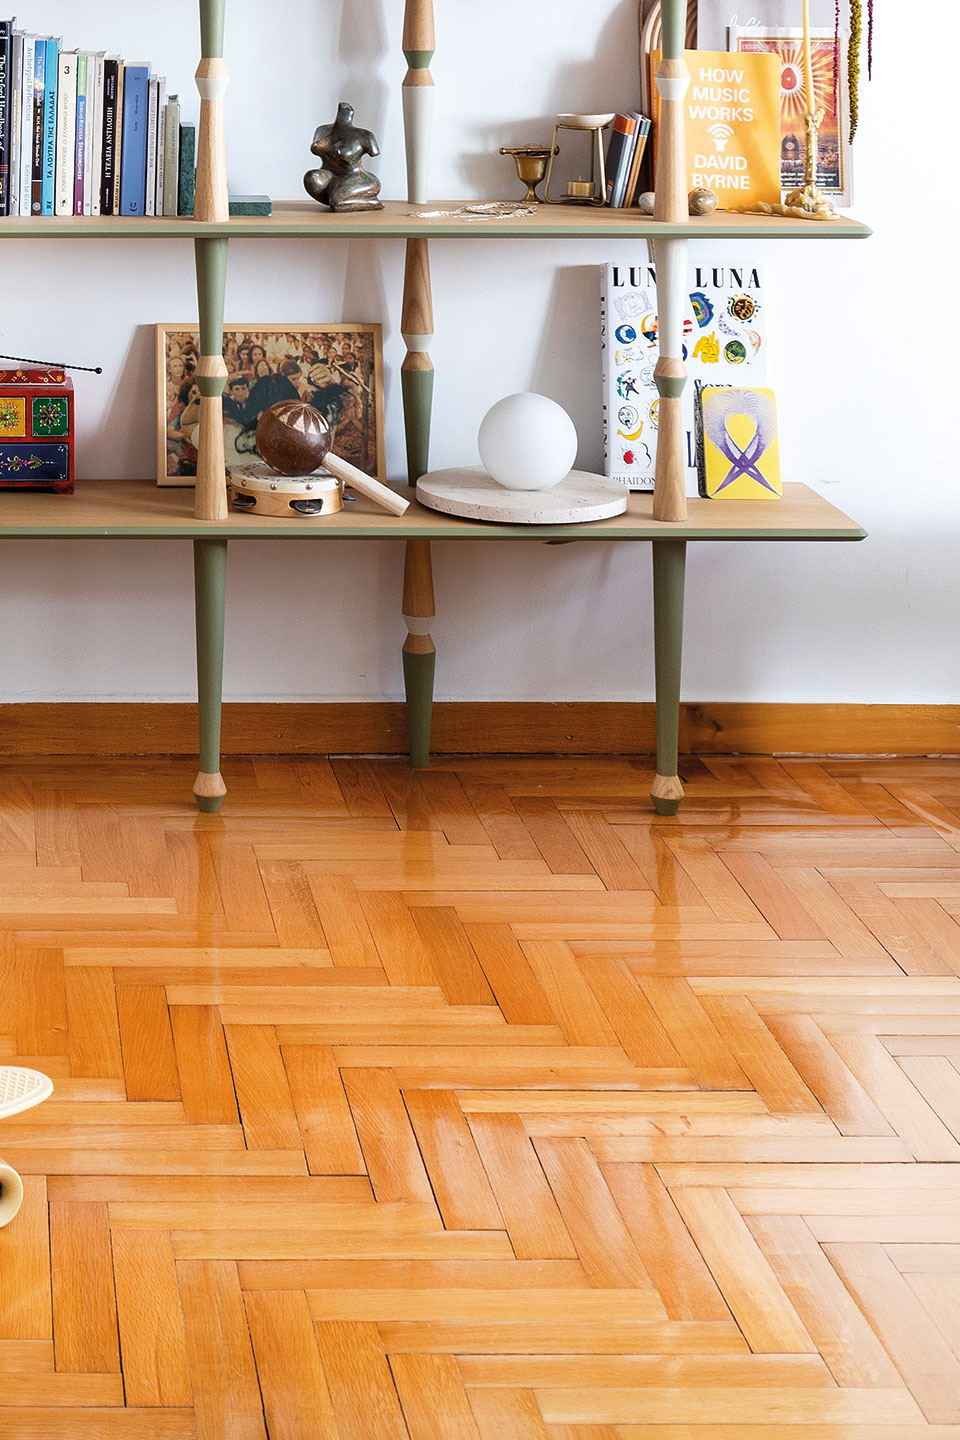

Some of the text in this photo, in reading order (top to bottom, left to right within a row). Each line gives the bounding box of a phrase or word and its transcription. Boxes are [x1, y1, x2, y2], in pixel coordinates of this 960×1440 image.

[64, 65, 70, 75] 3
[699, 68, 744, 84] HOW
[692, 87, 750, 103] MUSIC
[688, 106, 754, 122] WORKS
[105, 107, 114, 145] ΑΝΤΙΛΟΠΗ
[46, 141, 54, 168] ΛΟΥΤΡΑ
[104, 146, 113, 171] ΤΕΛΕΙΑ
[694, 154, 748, 171] DAVID
[46, 170, 53, 179] ΤΑ
[692, 174, 750, 190] BYRNE
[612, 267, 658, 287] LUN
[695, 267, 761, 289] LUNA
